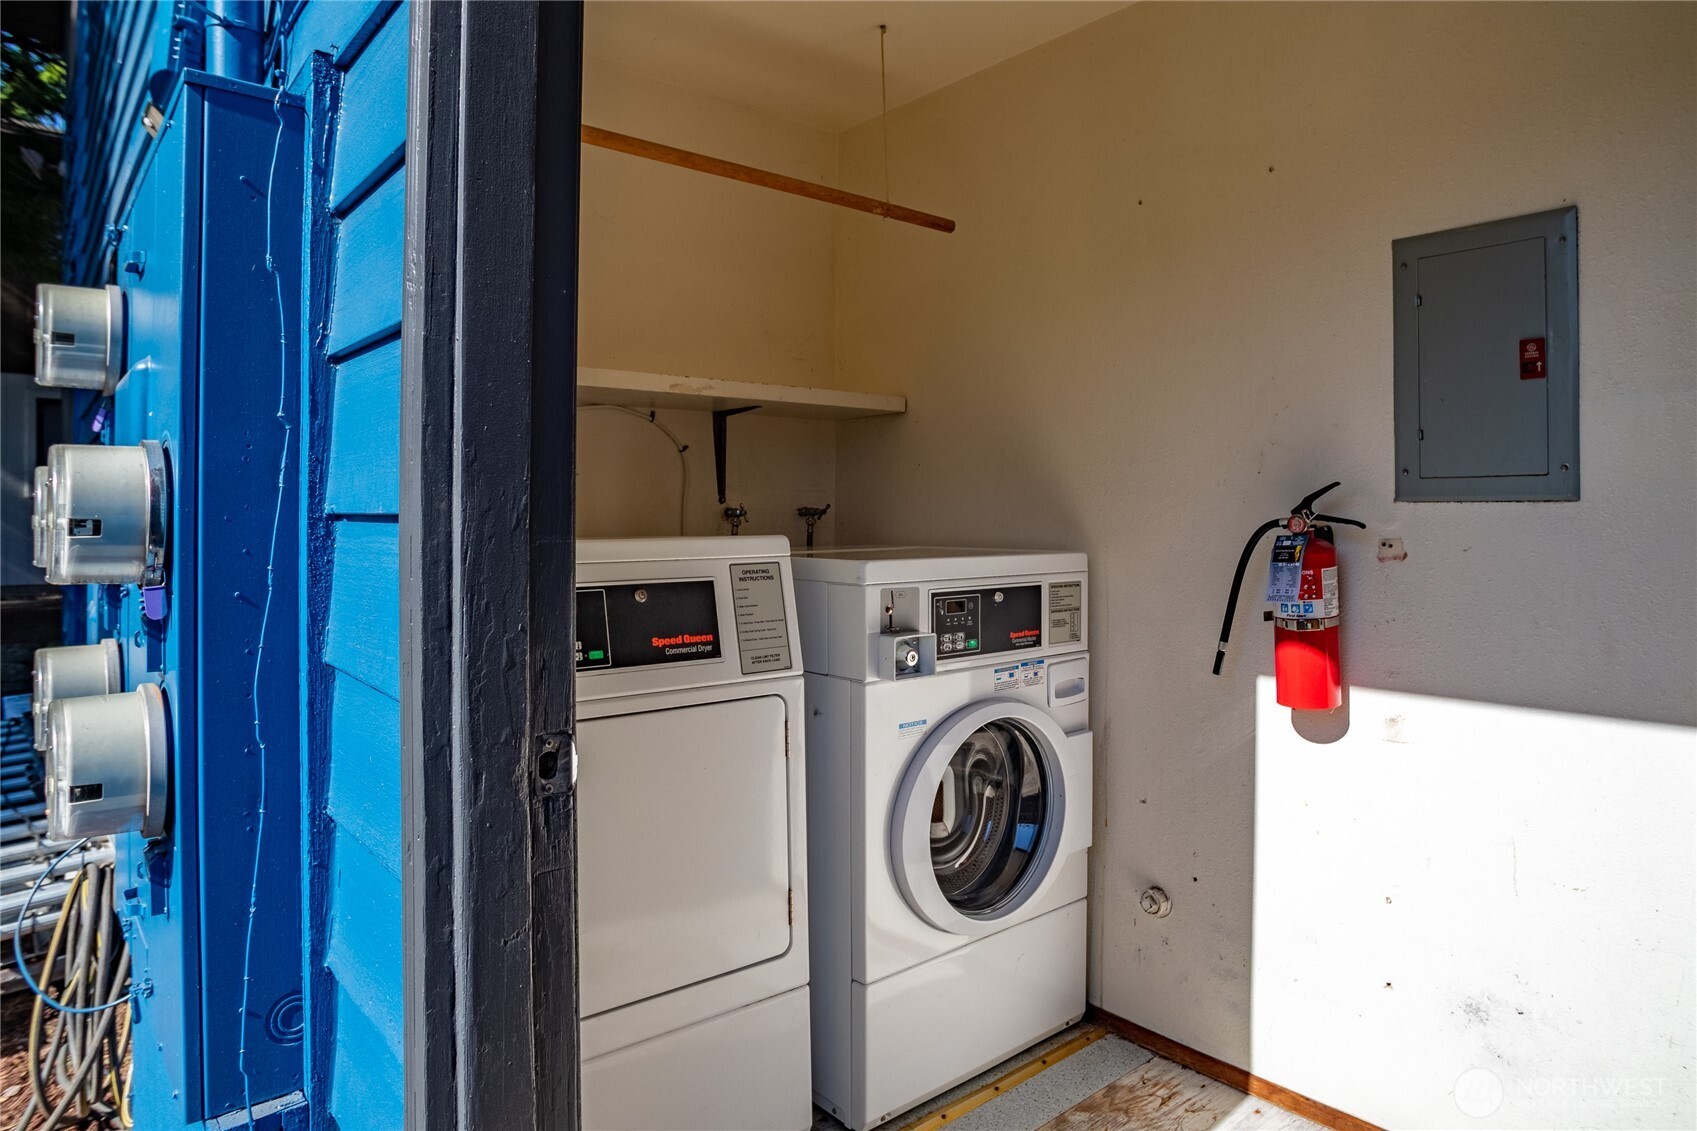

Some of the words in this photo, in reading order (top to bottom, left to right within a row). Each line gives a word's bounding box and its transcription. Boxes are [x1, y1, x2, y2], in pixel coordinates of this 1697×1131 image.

[1010, 630, 1025, 638] Speed
[651, 635, 683, 648] Speed
[683, 634, 713, 643] Queen
[665, 645, 697, 655] Commercial
[698, 645, 713, 653] Dryer
